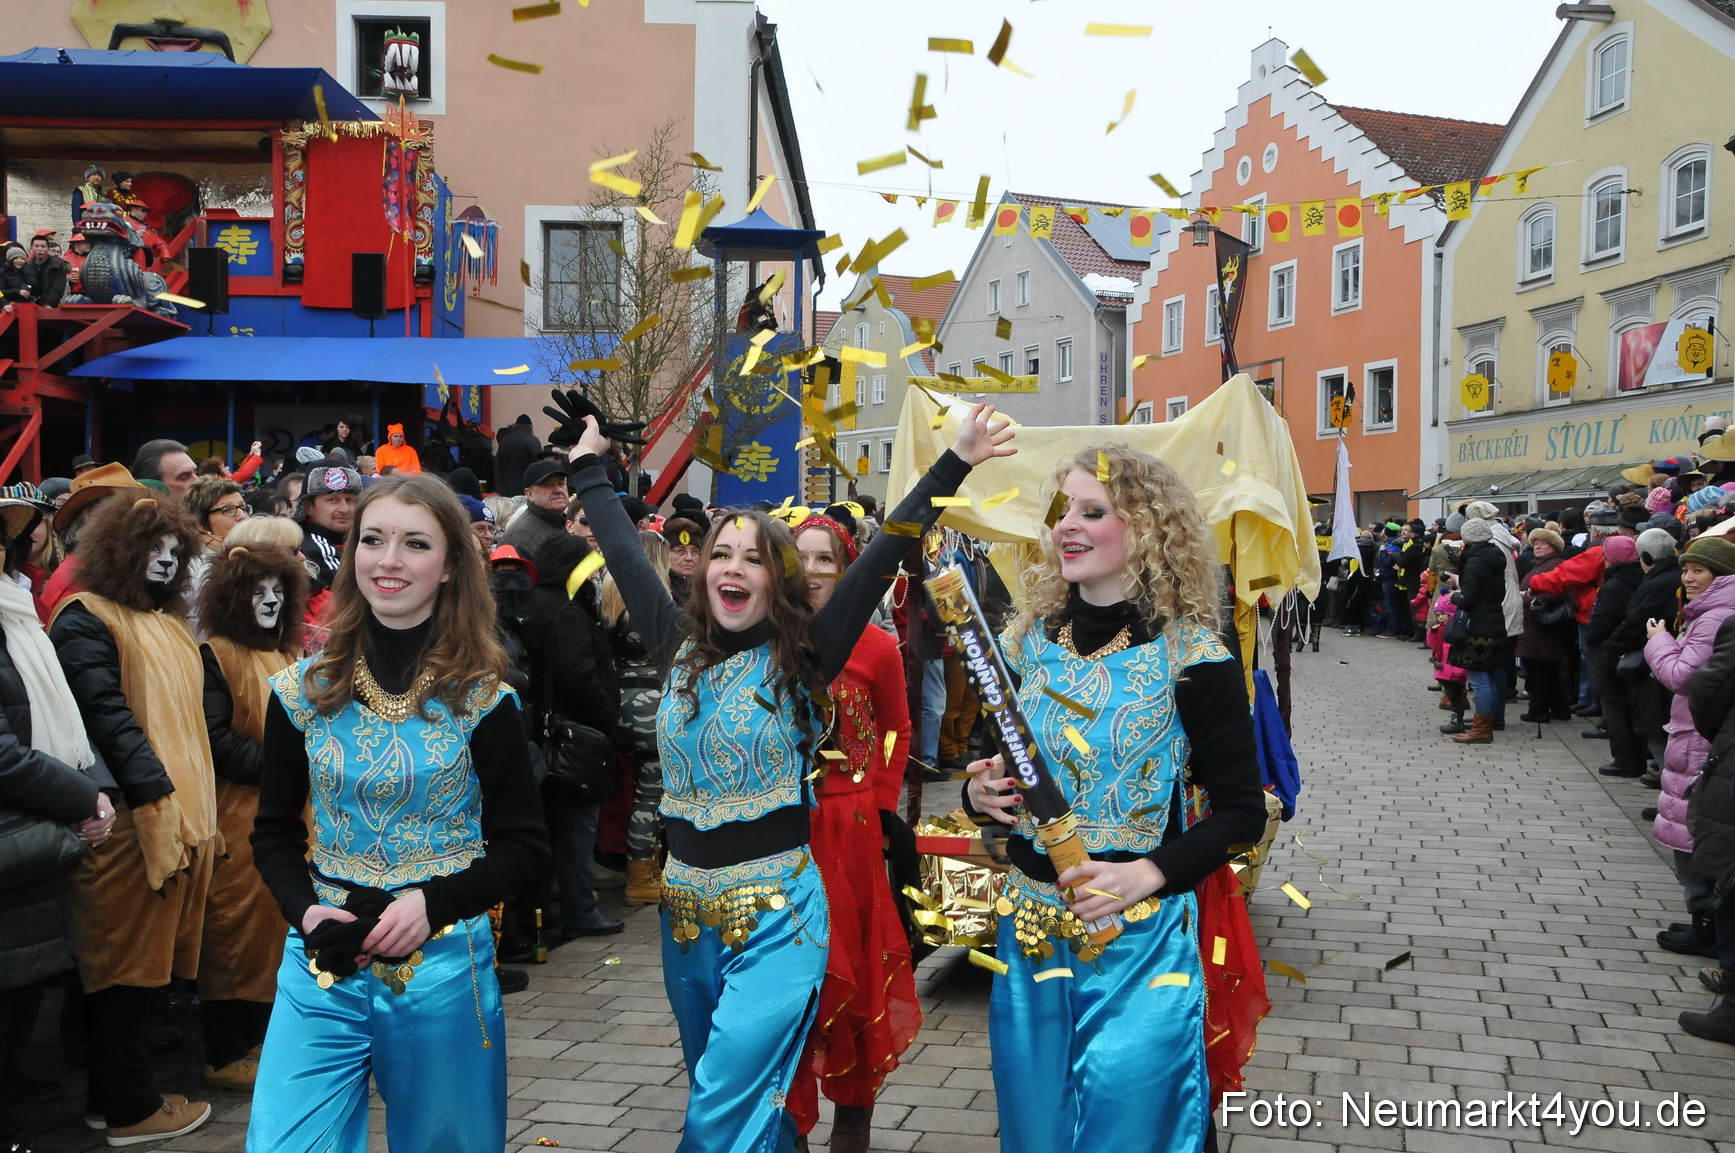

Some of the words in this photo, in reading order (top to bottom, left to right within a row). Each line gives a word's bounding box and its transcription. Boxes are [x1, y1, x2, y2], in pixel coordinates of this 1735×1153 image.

[1100, 353, 1108, 407] UHREN
[1458, 434, 1529, 463] BÄCKEREI
[1545, 418, 1625, 462] STOLL
[960, 628, 1004, 707] CANNON
